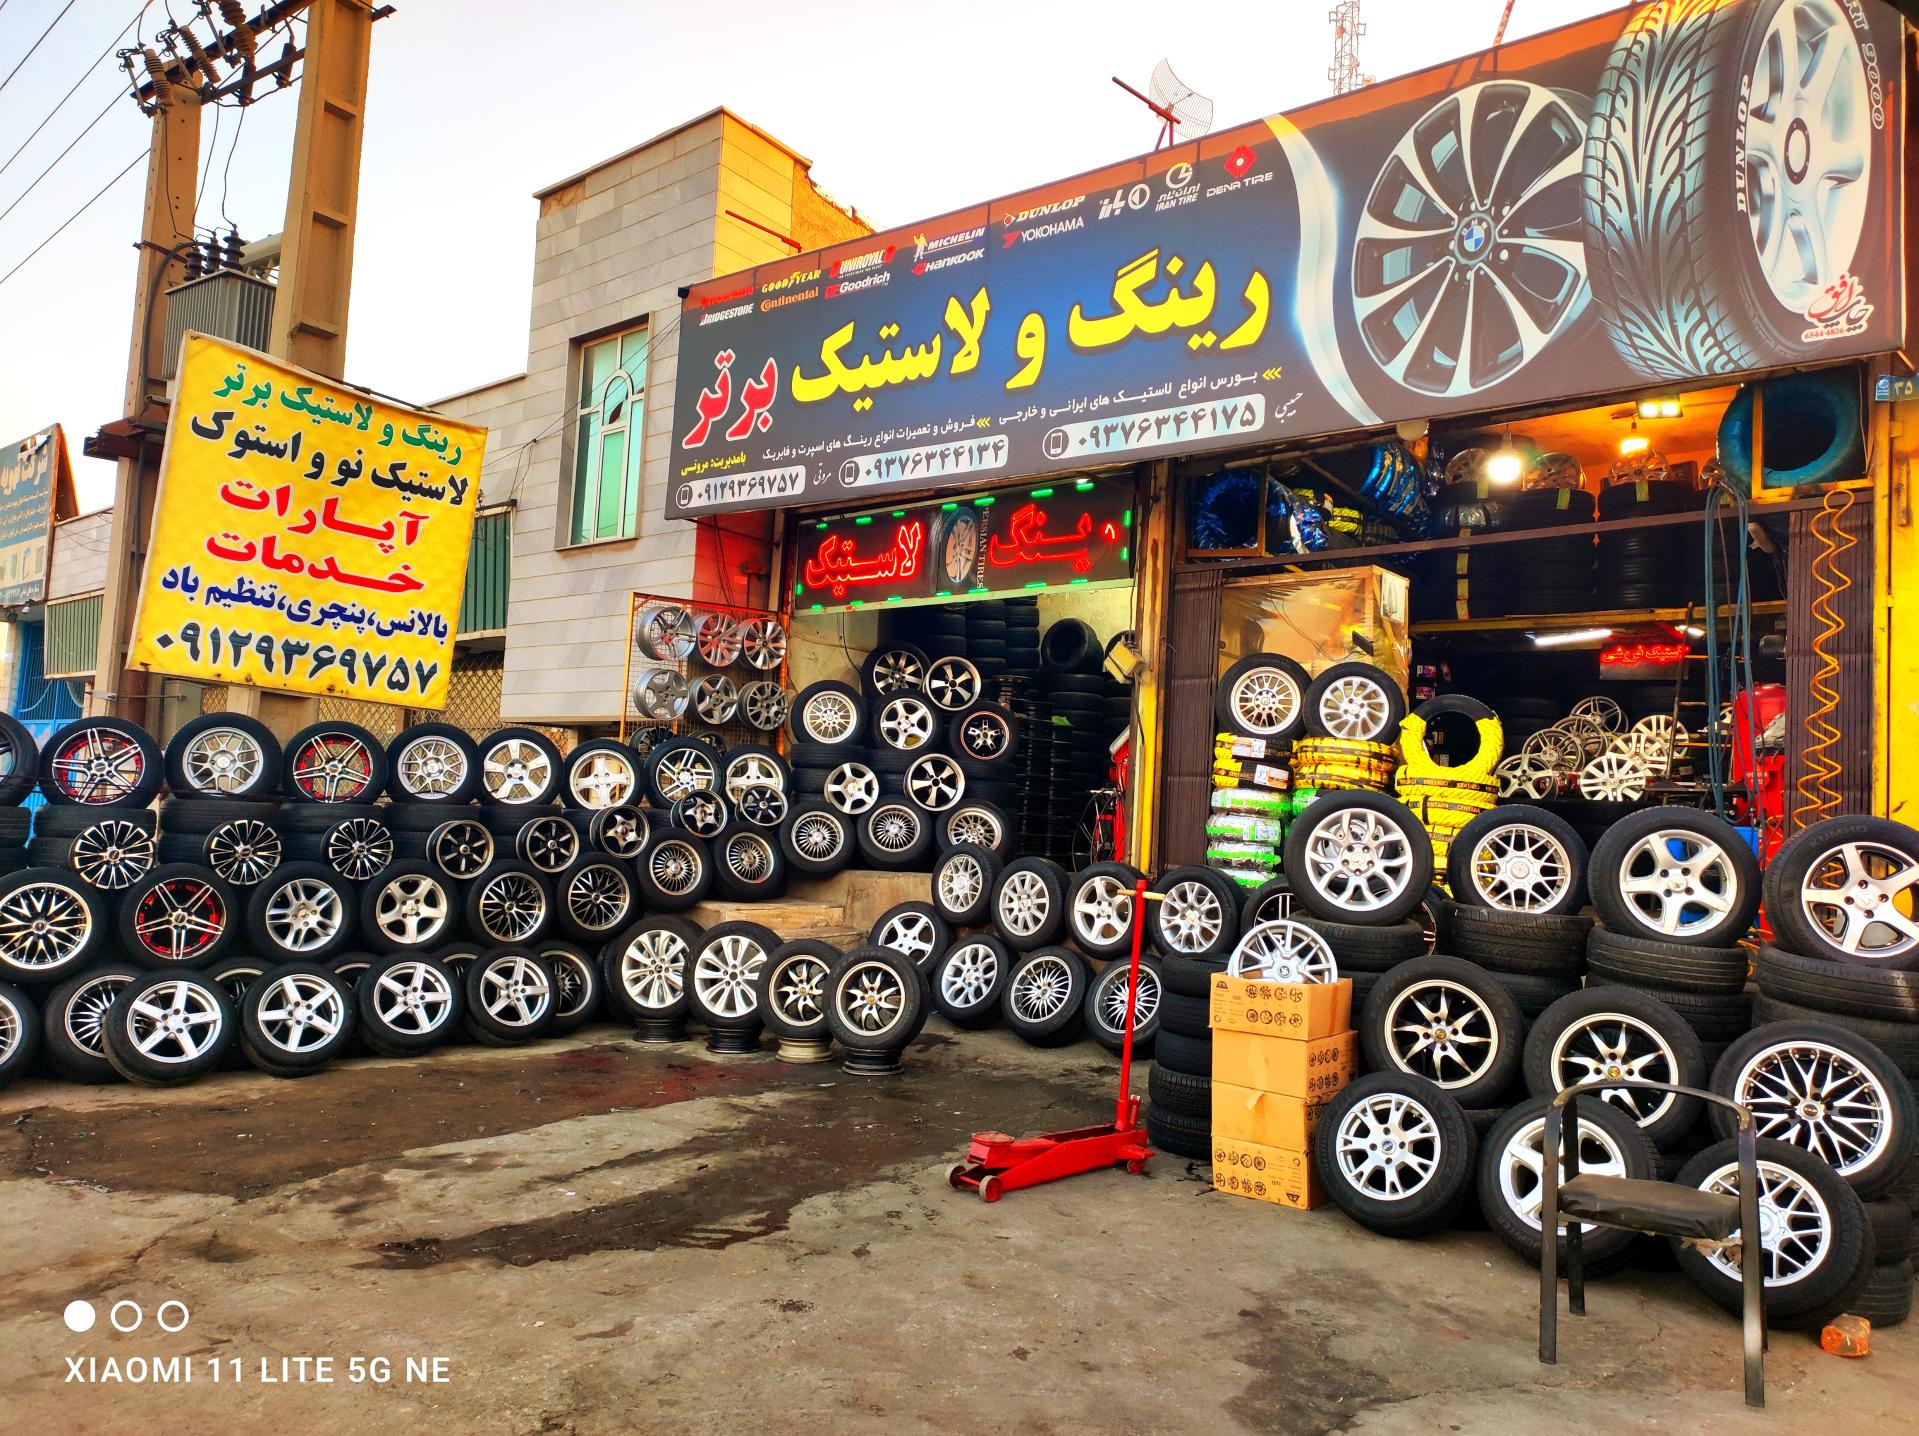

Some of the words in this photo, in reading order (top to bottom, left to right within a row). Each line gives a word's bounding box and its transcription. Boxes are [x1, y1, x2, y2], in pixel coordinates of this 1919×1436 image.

[1862, 43, 1884, 129] 9000
[1736, 74, 1750, 213] DUNLOP
[1206, 182, 1241, 197] DENA
[1244, 172, 1273, 187] TIRE
[1016, 195, 1086, 223] DUNLOP
[1155, 199, 1176, 213] IRAN
[1179, 193, 1198, 206] TIRE
[928, 227, 985, 250] MICHELIN
[1021, 216, 1084, 243] YOKOHAMA
[840, 250, 883, 275] UNIROYAL
[762, 270, 821, 293] GOODYEAR
[761, 287, 819, 312] Continental
[1069, 248, 1269, 350] رینگ
[699, 303, 754, 326] BRIDGESTONE
[792, 287, 990, 412] لاستیک
[1006, 313, 1046, 389] و
[213, 364, 272, 409] برتر
[1113, 382, 1172, 400] لاستیک
[1178, 375, 1207, 398] انواع
[1210, 372, 1257, 390] بورس
[280, 387, 373, 431] لاستیک
[682, 349, 778, 449] برتر
[1049, 397, 1087, 417] ایرانی
[1089, 395, 1110, 411] های
[940, 415, 976, 435] فروش
[999, 406, 1038, 425] خارجی
[1040, 408, 1046, 418] و
[1078, 400, 1256, 448] ۰۹۳۷۶۳۴۴۱۷۵
[191, 411, 302, 462] استوک
[378, 422, 394, 447] و
[401, 423, 463, 466] رینگ
[843, 434, 872, 448] رینگ
[874, 428, 895, 447] انواع
[897, 423, 931, 440] تعمیرات
[933, 427, 939, 435] و
[762, 445, 790, 462] فابریک
[798, 440, 825, 457] اسپرت
[826, 441, 841, 452] های
[865, 439, 1005, 480] ۰۹۳۷۶۳۴۴۱۳۴
[304, 451, 325, 478] و
[330, 449, 364, 487] نو
[371, 462, 468, 506] لاستیک
[698, 471, 798, 502] ۰۹۱۲۹۳۶۹۷۵۷
[220, 479, 430, 554] آپارات
[979, 504, 990, 552] PERSIAN
[205, 530, 425, 594] خدمات
[806, 521, 922, 596] لاستیک
[977, 554, 986, 589] TIRES
[162, 566, 200, 601] باد
[156, 622, 438, 694] ۰۹۱۲۹۳۶۹۷۵۷
